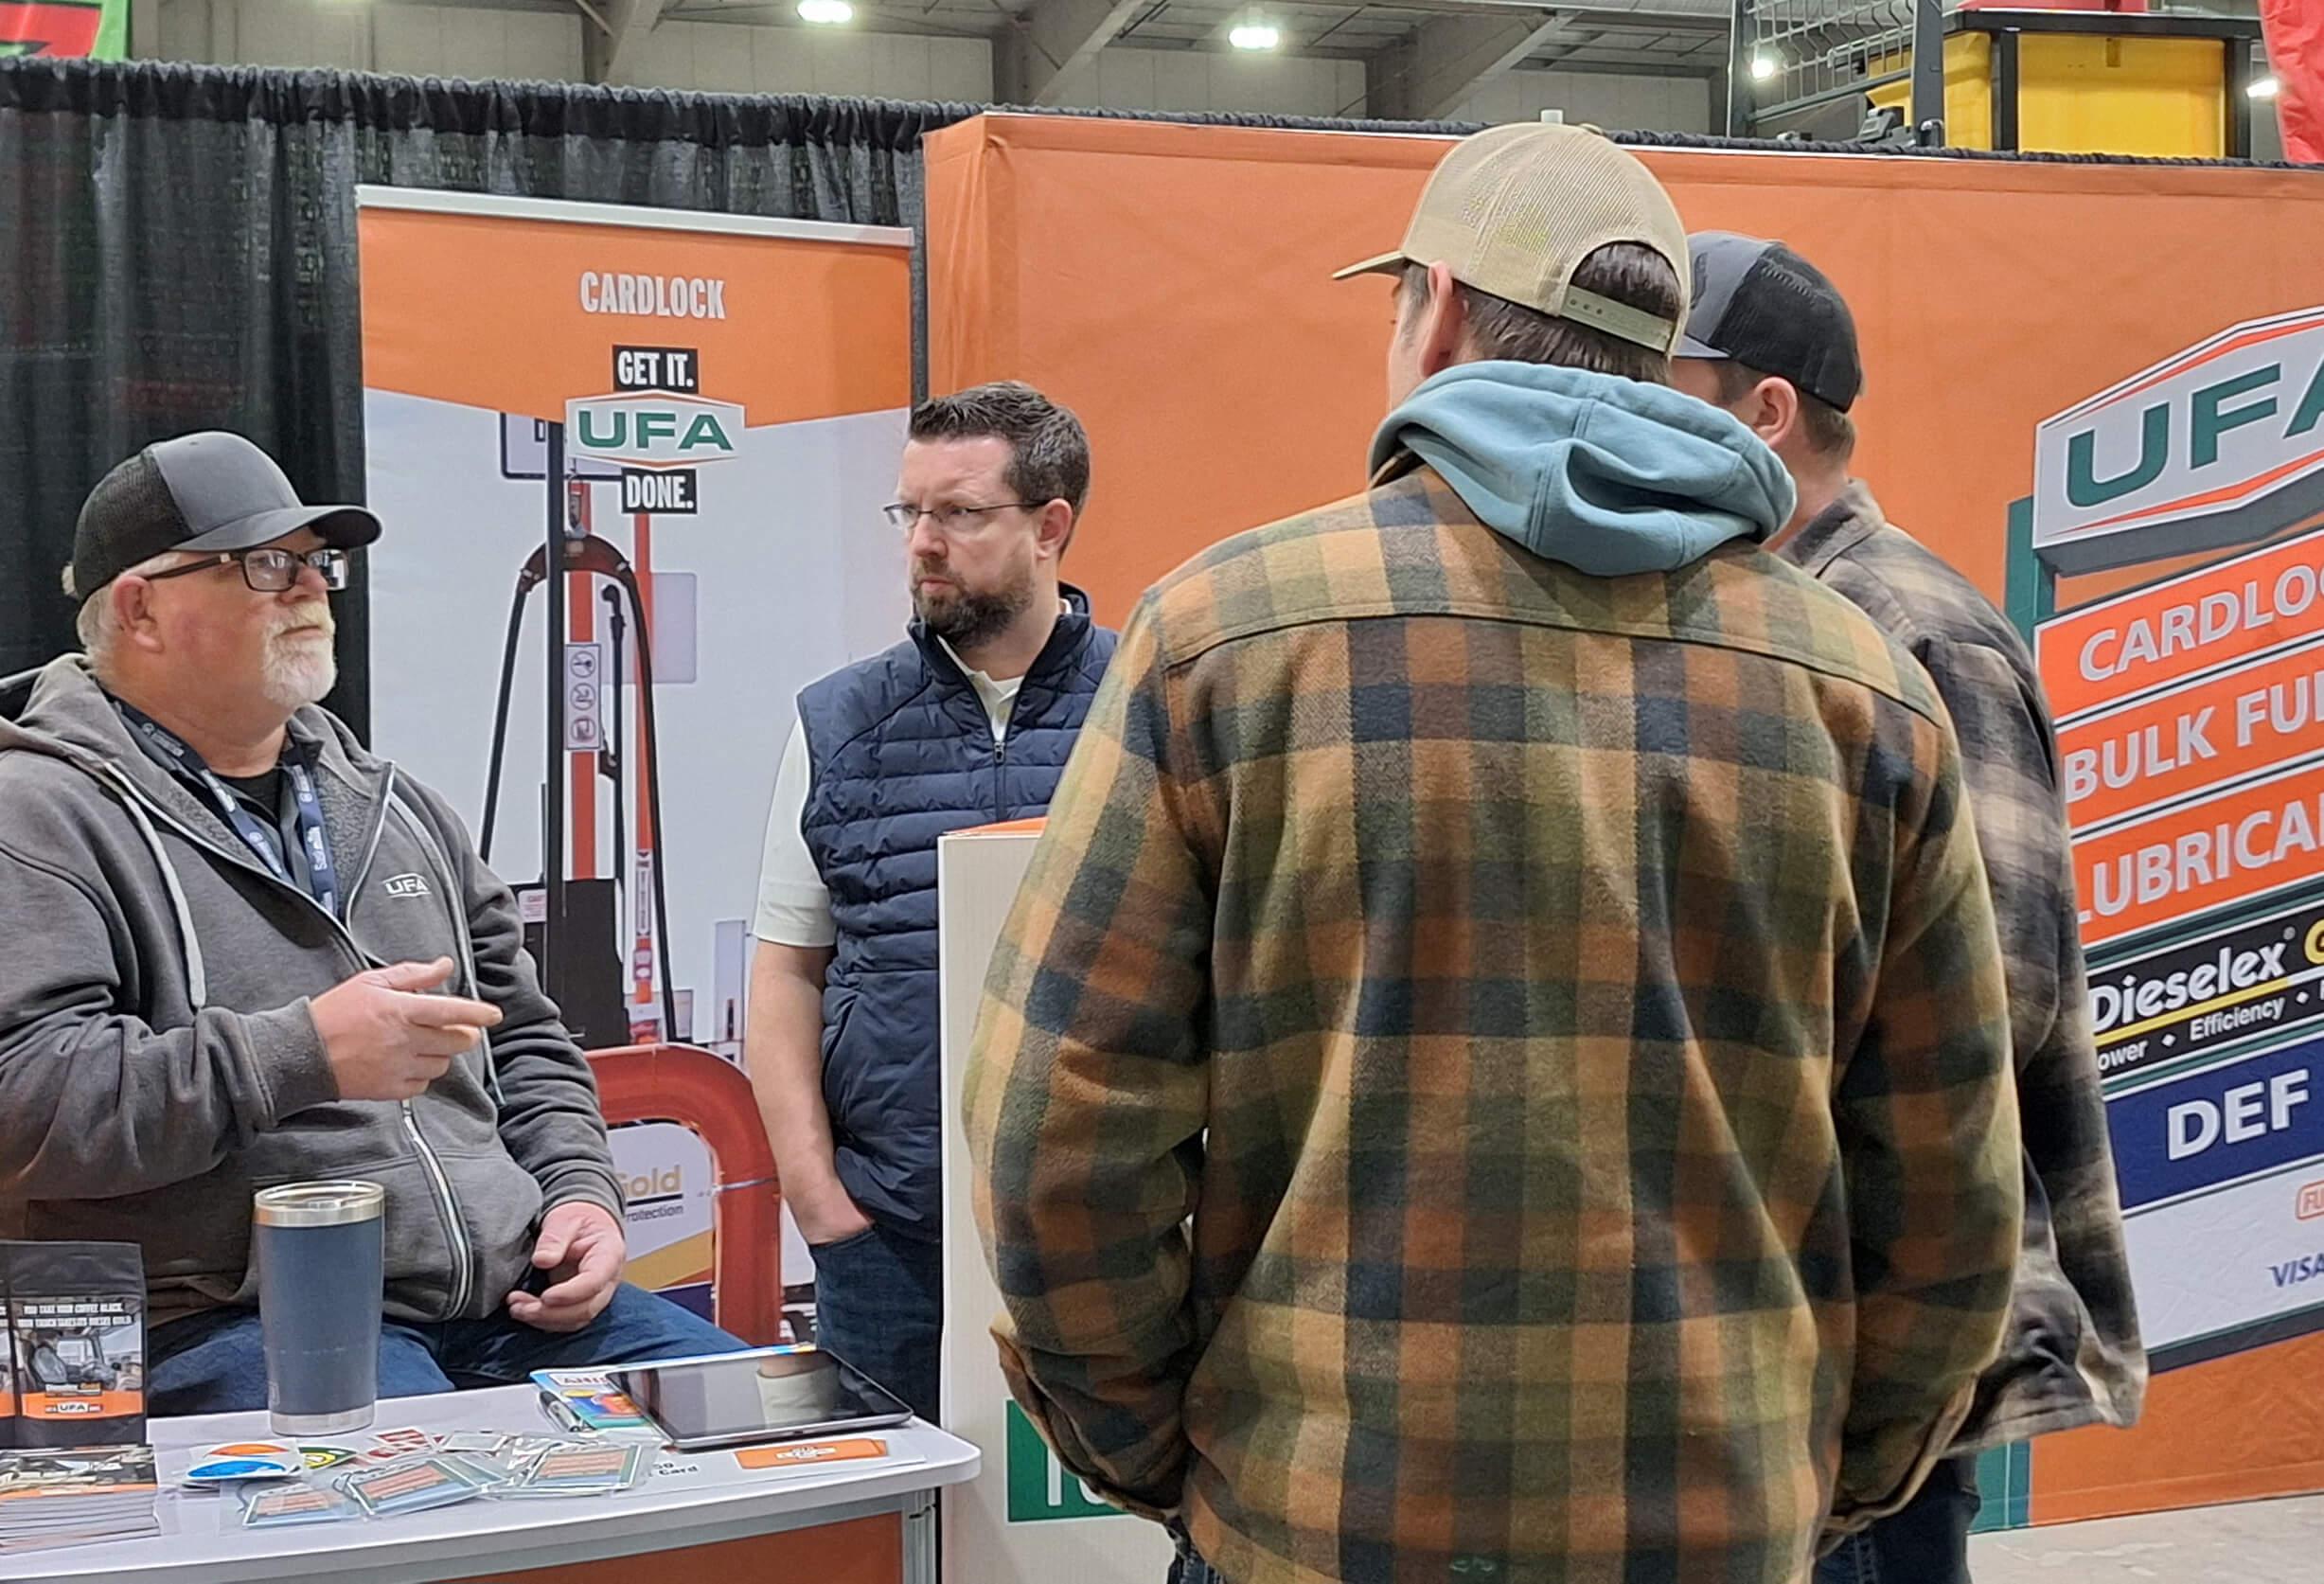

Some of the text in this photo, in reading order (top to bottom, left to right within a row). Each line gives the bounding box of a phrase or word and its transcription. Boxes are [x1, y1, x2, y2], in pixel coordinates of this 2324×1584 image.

[580, 271, 726, 319] CARDLOCK
[617, 350, 695, 387] GET IT.
[577, 410, 734, 452] UFA
[626, 474, 695, 509] DONE.
[2064, 671, 2324, 804] BULK FU
[2078, 792, 2324, 924] UBRICA
[384, 878, 429, 895] UFA
[2097, 997, 2286, 1072] ower Efficiency
[2167, 1068, 2310, 1162] DEF
[627, 1204, 683, 1223] rotection
